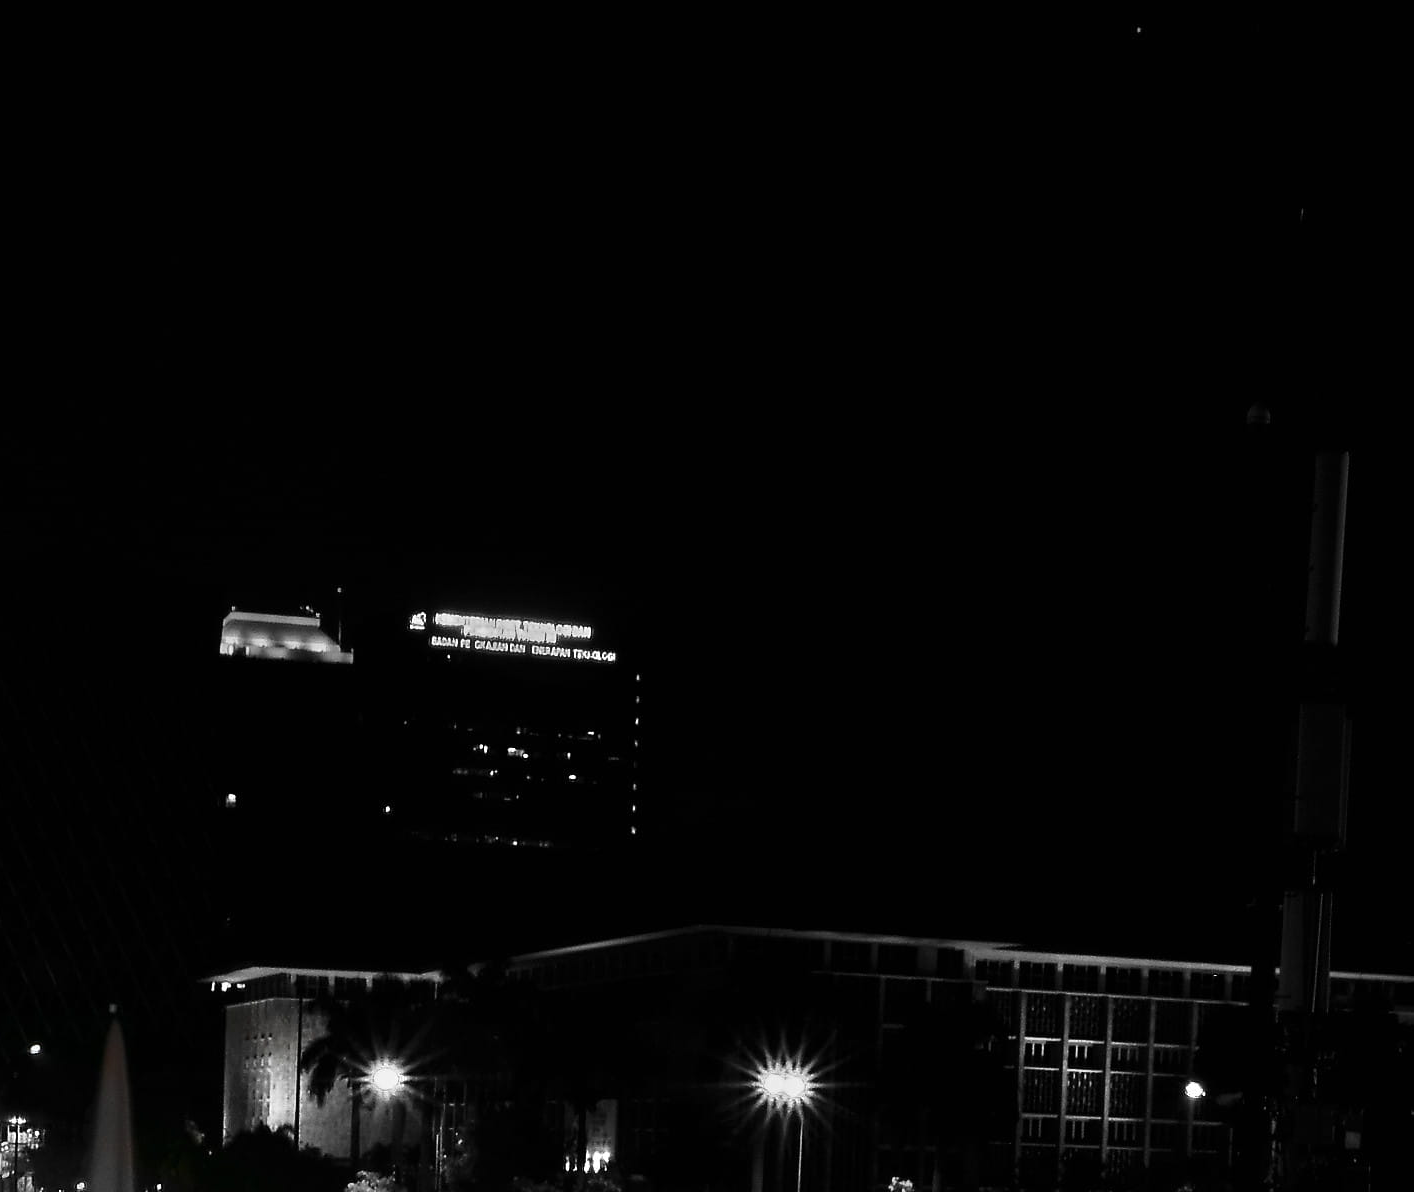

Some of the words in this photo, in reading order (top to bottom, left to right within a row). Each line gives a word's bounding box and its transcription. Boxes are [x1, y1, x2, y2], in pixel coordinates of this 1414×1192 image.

[431, 635, 459, 648] BADAN
[460, 638, 508, 652] PEGKAJIAN
[509, 642, 526, 653] DAN
[529, 645, 571, 658] ENERAPAN
